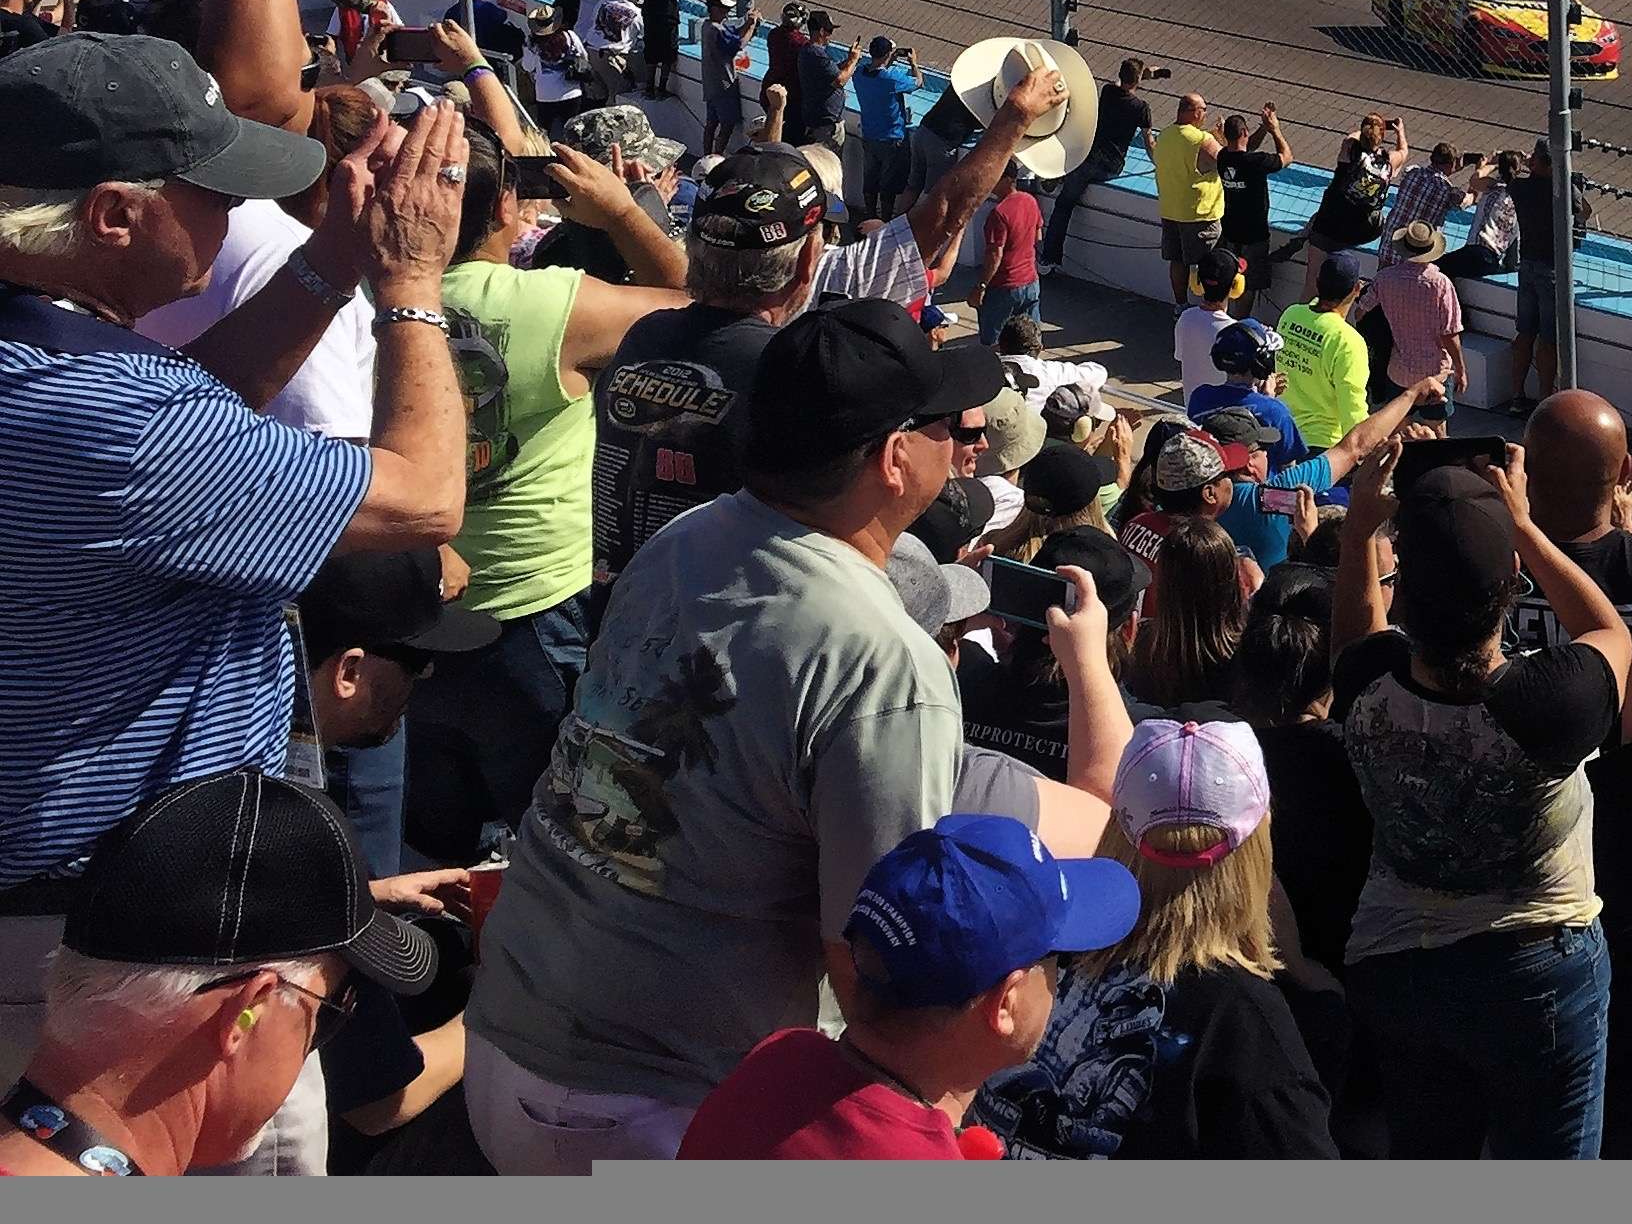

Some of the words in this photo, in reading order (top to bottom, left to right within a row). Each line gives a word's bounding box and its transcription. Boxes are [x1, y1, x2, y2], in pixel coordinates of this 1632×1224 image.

[759, 221, 788, 243] 88
[662, 365, 693, 379] 2012
[608, 370, 729, 416] SCHEDULE
